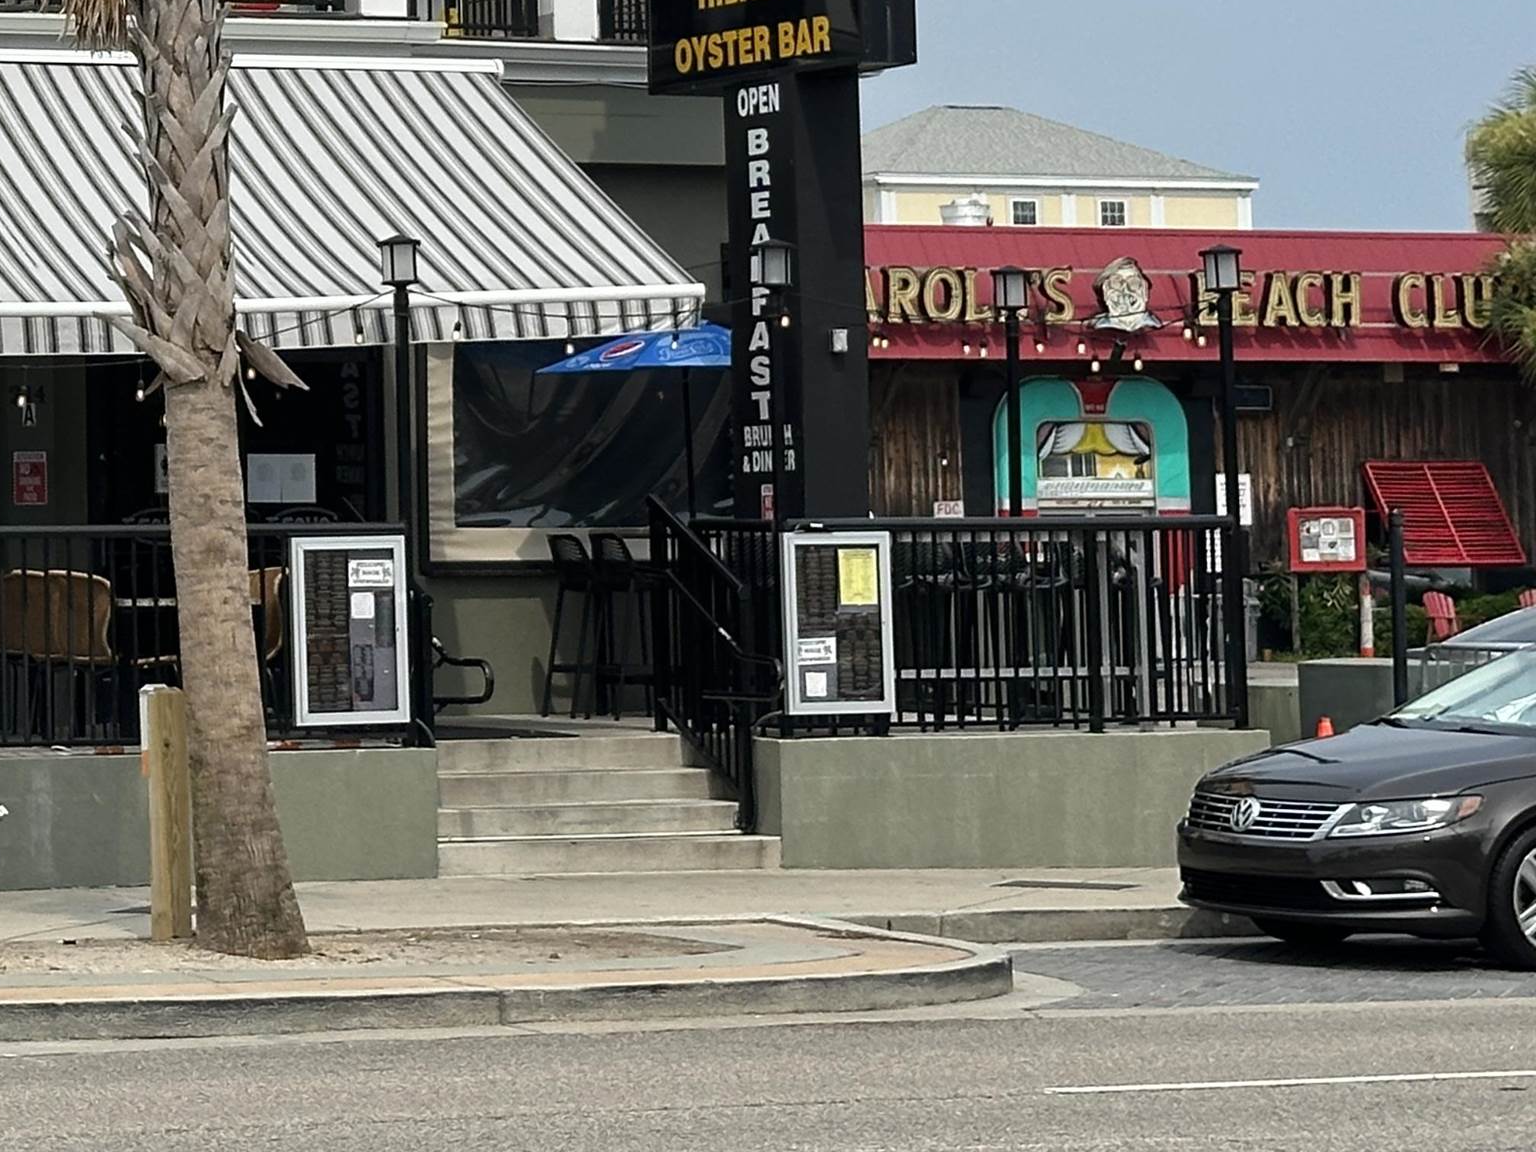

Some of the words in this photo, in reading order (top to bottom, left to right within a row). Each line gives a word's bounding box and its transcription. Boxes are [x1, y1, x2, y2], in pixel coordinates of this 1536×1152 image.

[674, 25, 771, 74] OYSTER
[778, 16, 831, 59] BAR
[737, 83, 780, 117] OPEN
[1398, 272, 1497, 329] CLU
[743, 424, 799, 448] BRUH
[936, 502, 961, 515] FDC
